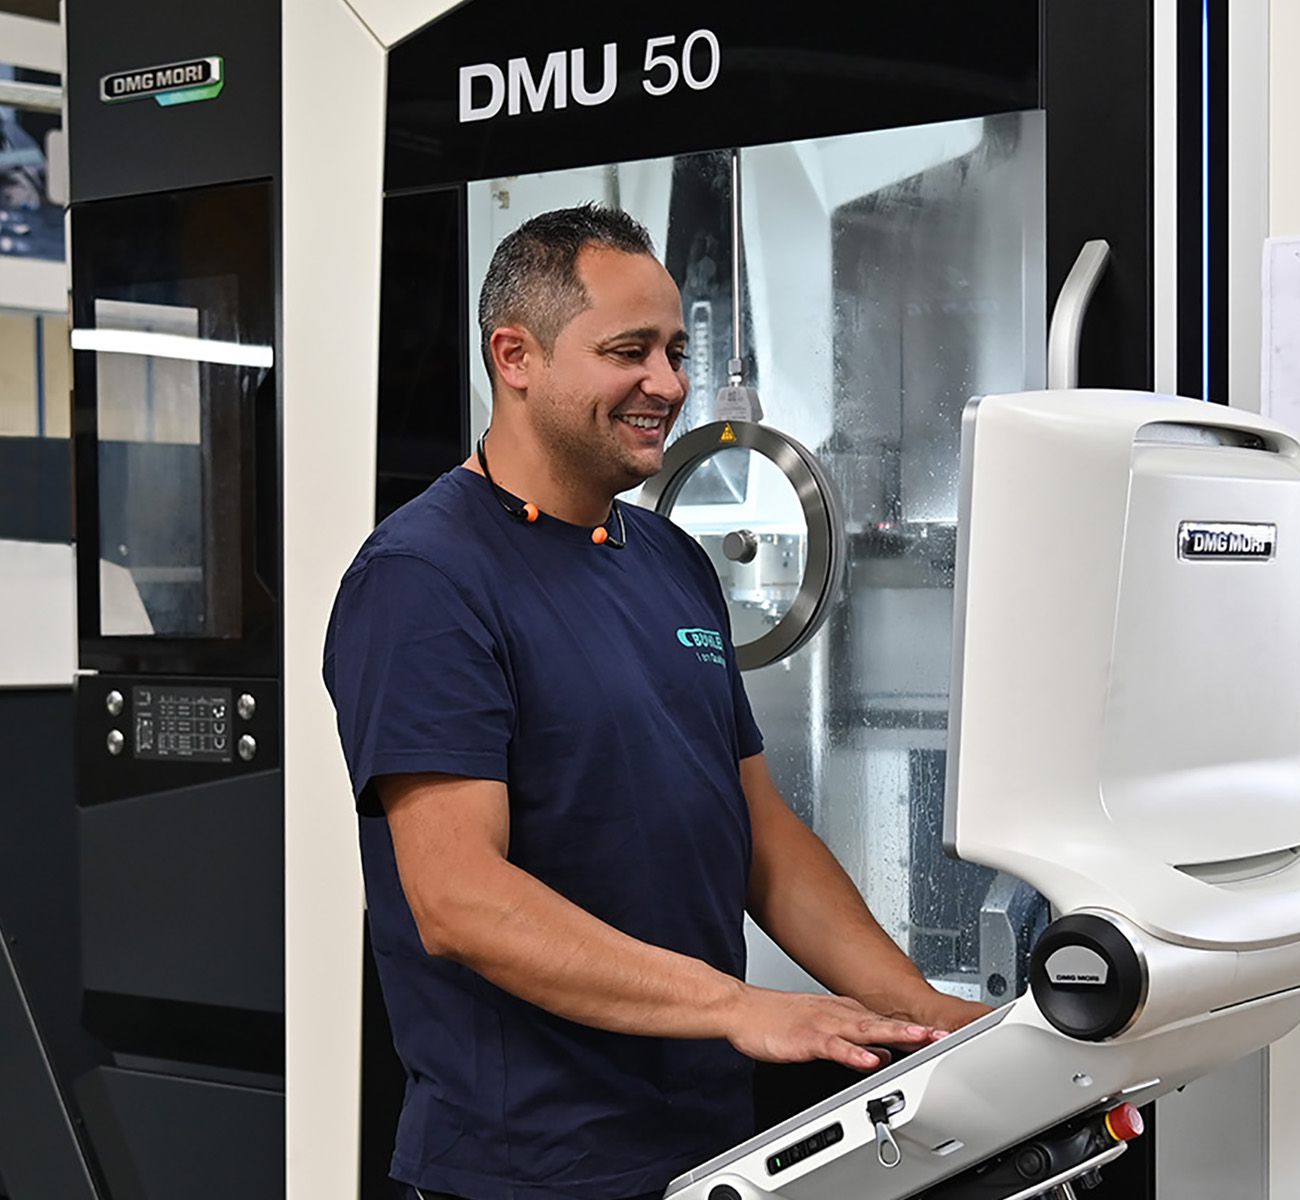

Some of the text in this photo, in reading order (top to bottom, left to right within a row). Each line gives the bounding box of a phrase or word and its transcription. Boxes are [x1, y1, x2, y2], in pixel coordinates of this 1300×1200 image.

[113, 64, 203, 94] DMG MORI
[459, 29, 720, 122] DMU 50
[1193, 533, 1265, 553] DMG MORI
